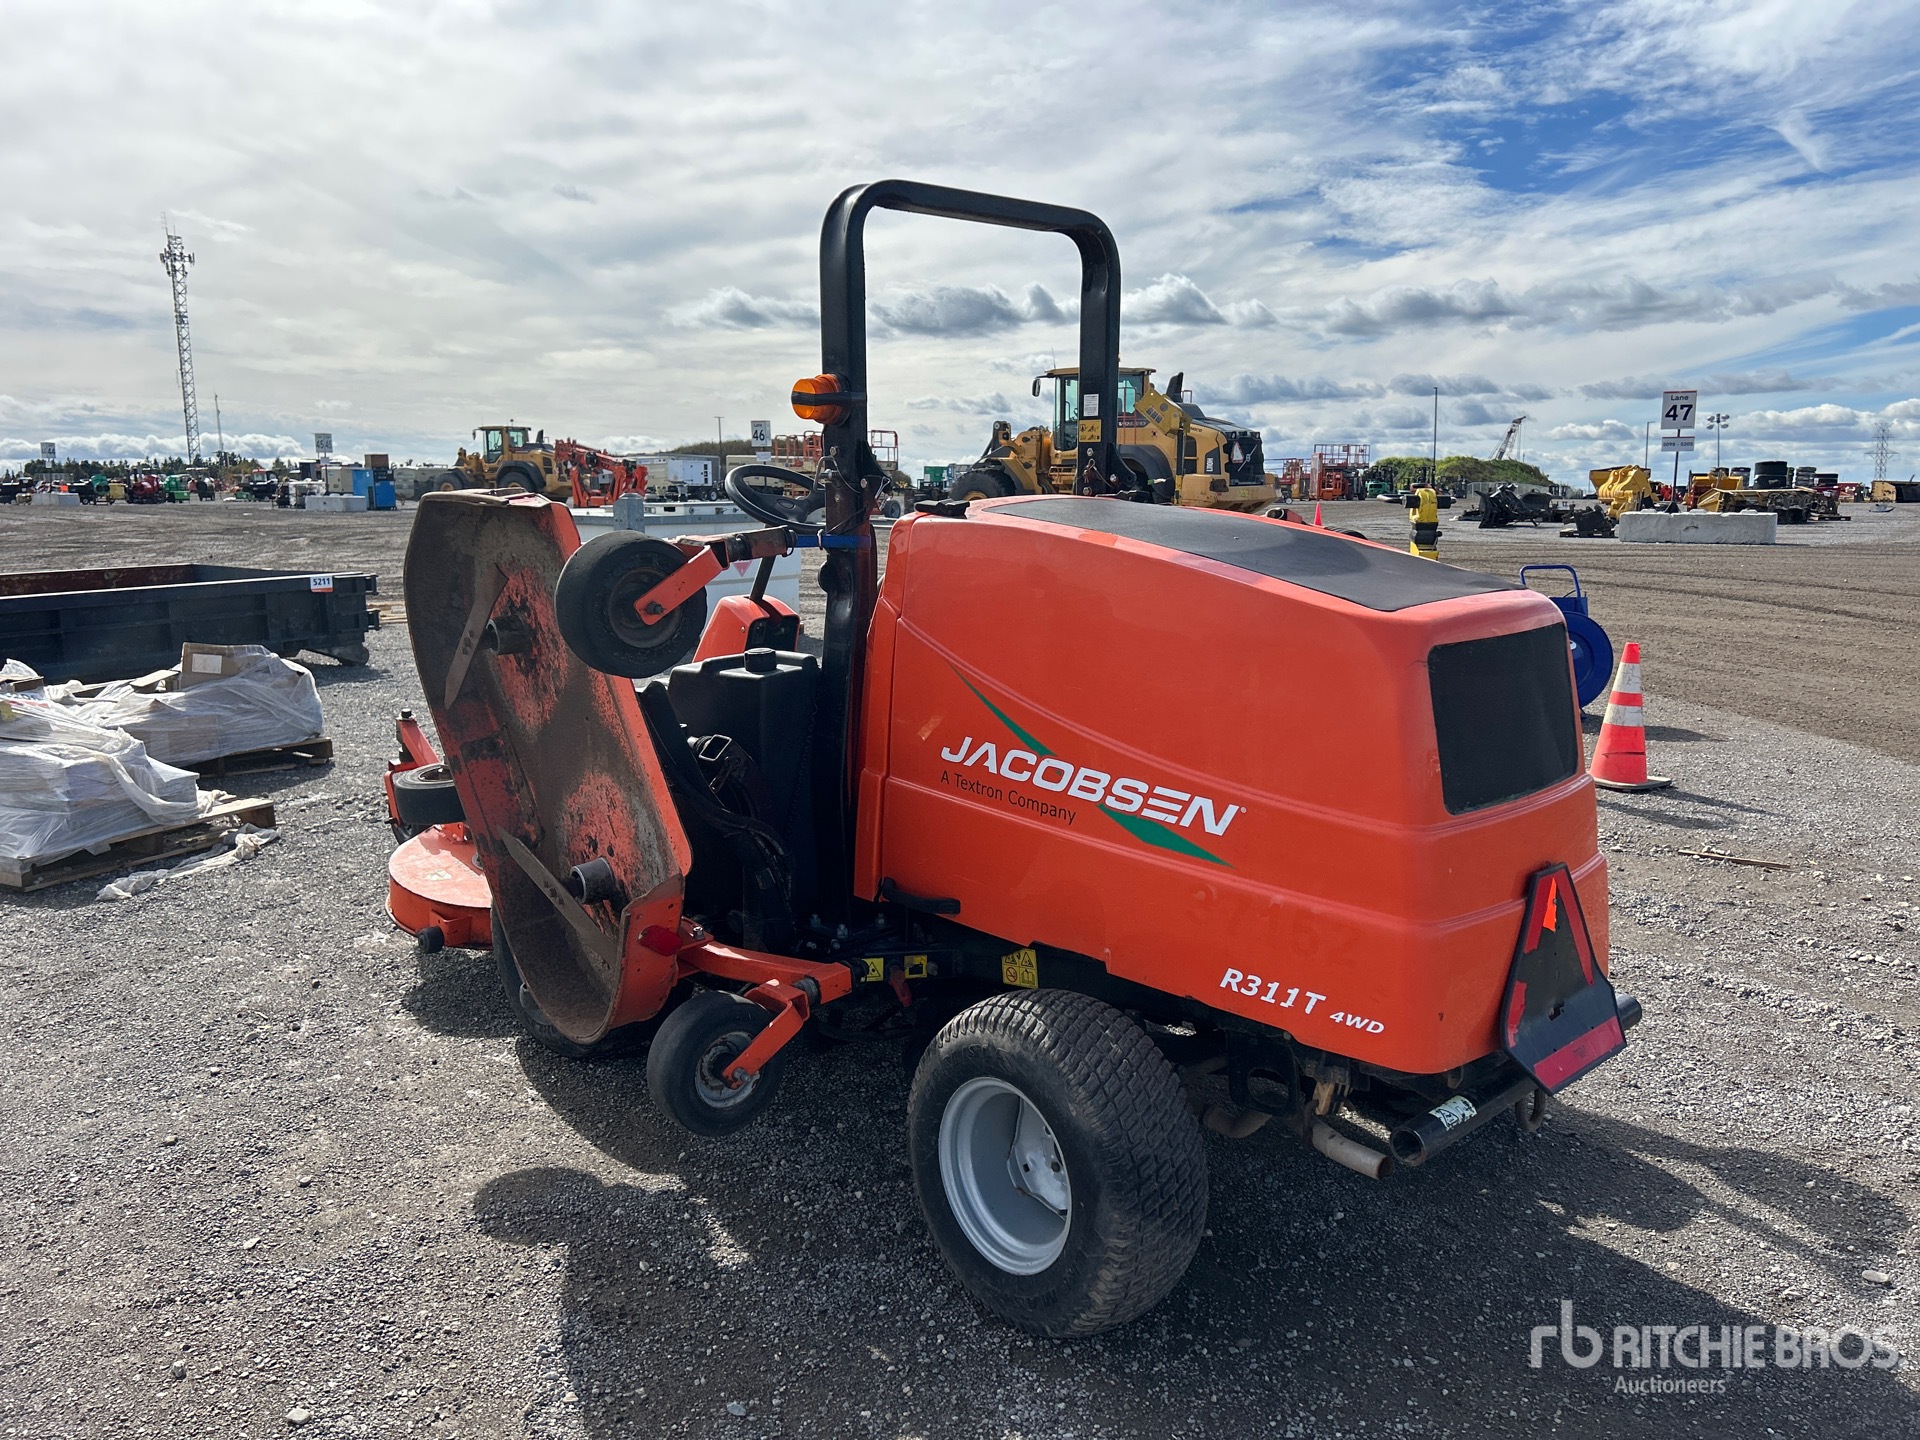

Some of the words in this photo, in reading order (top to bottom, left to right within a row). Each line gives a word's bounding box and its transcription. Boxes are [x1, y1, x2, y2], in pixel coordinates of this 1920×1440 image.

[1665, 404, 1693, 421] 47
[752, 429, 765, 441] 46
[313, 577, 330, 586] 5211
[940, 736, 1240, 837] JACOBSEN
[940, 769, 950, 785] A
[954, 772, 1003, 802] Textron
[1007, 789, 1077, 826] Company
[1219, 966, 1327, 1015] R311T
[1329, 1010, 1386, 1034] 4WD
